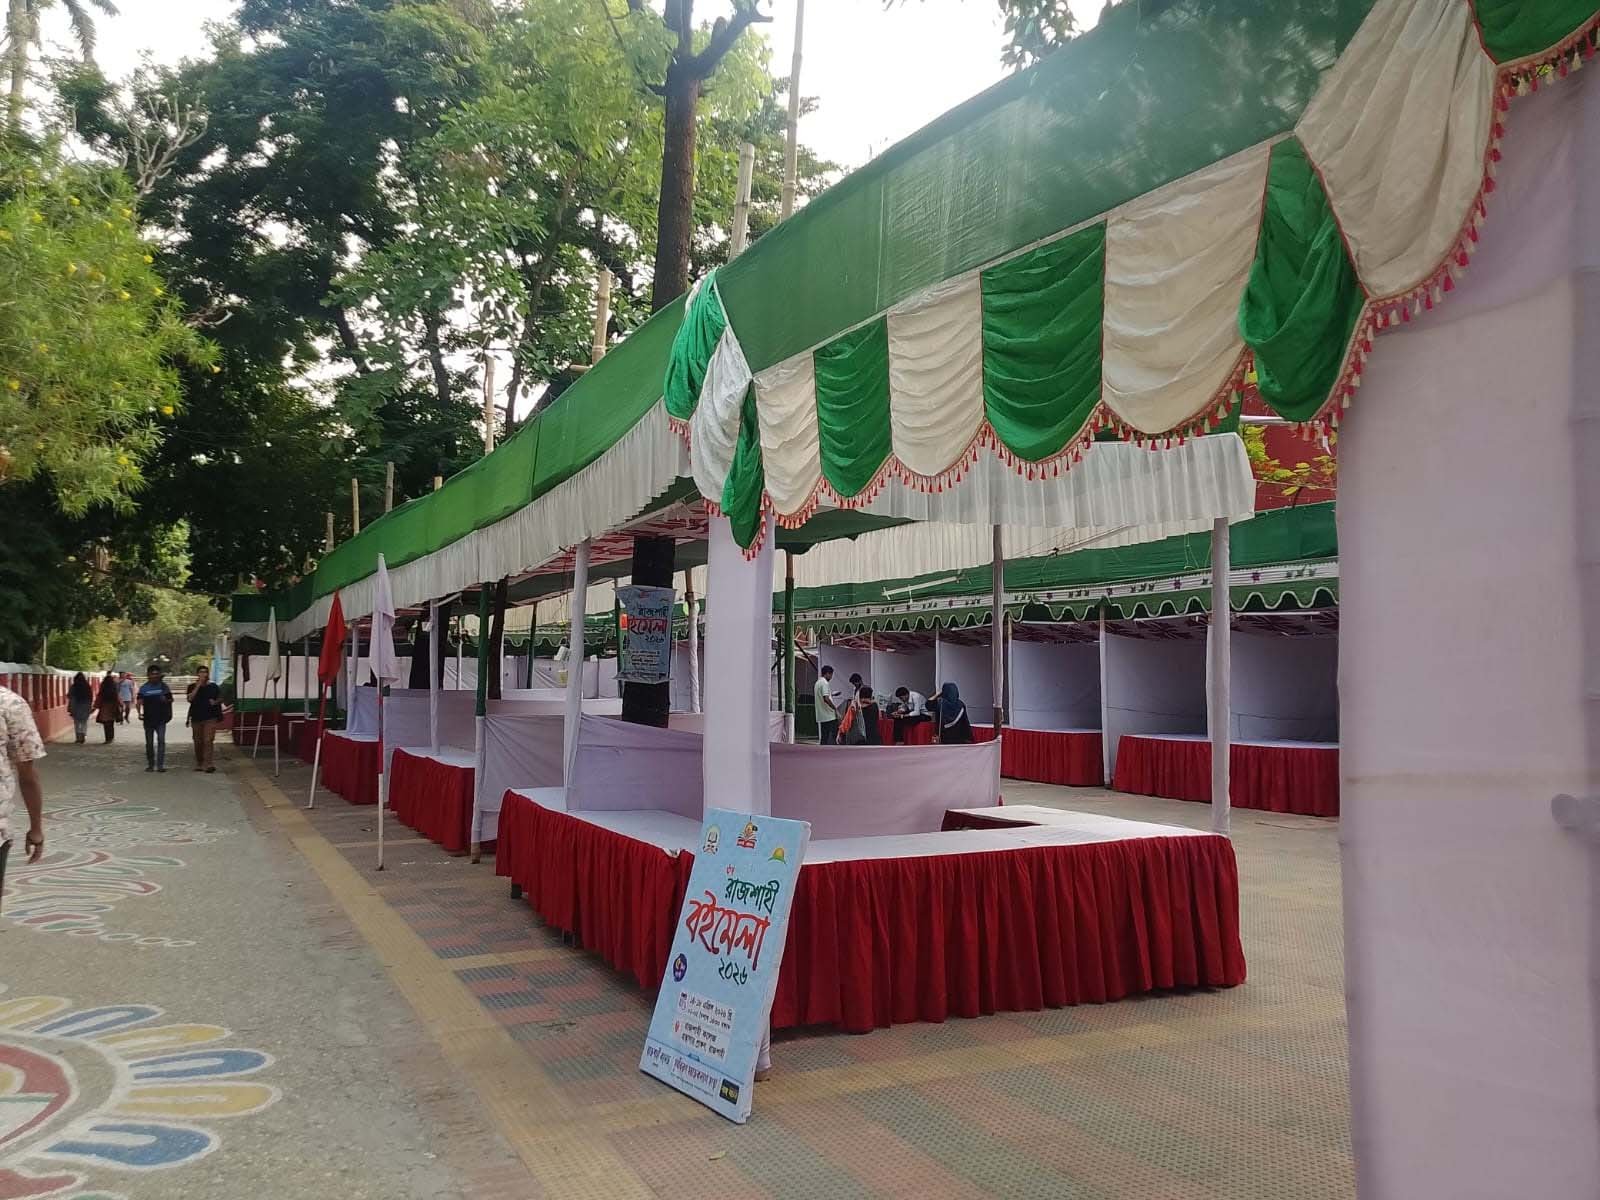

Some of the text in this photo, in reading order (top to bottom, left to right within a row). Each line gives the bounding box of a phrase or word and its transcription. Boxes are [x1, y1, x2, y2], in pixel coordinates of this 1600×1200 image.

[725, 878, 780, 915] রাজশাহী
[685, 890, 771, 971] বইমেলা
[718, 957, 748, 985] ২০২৬
